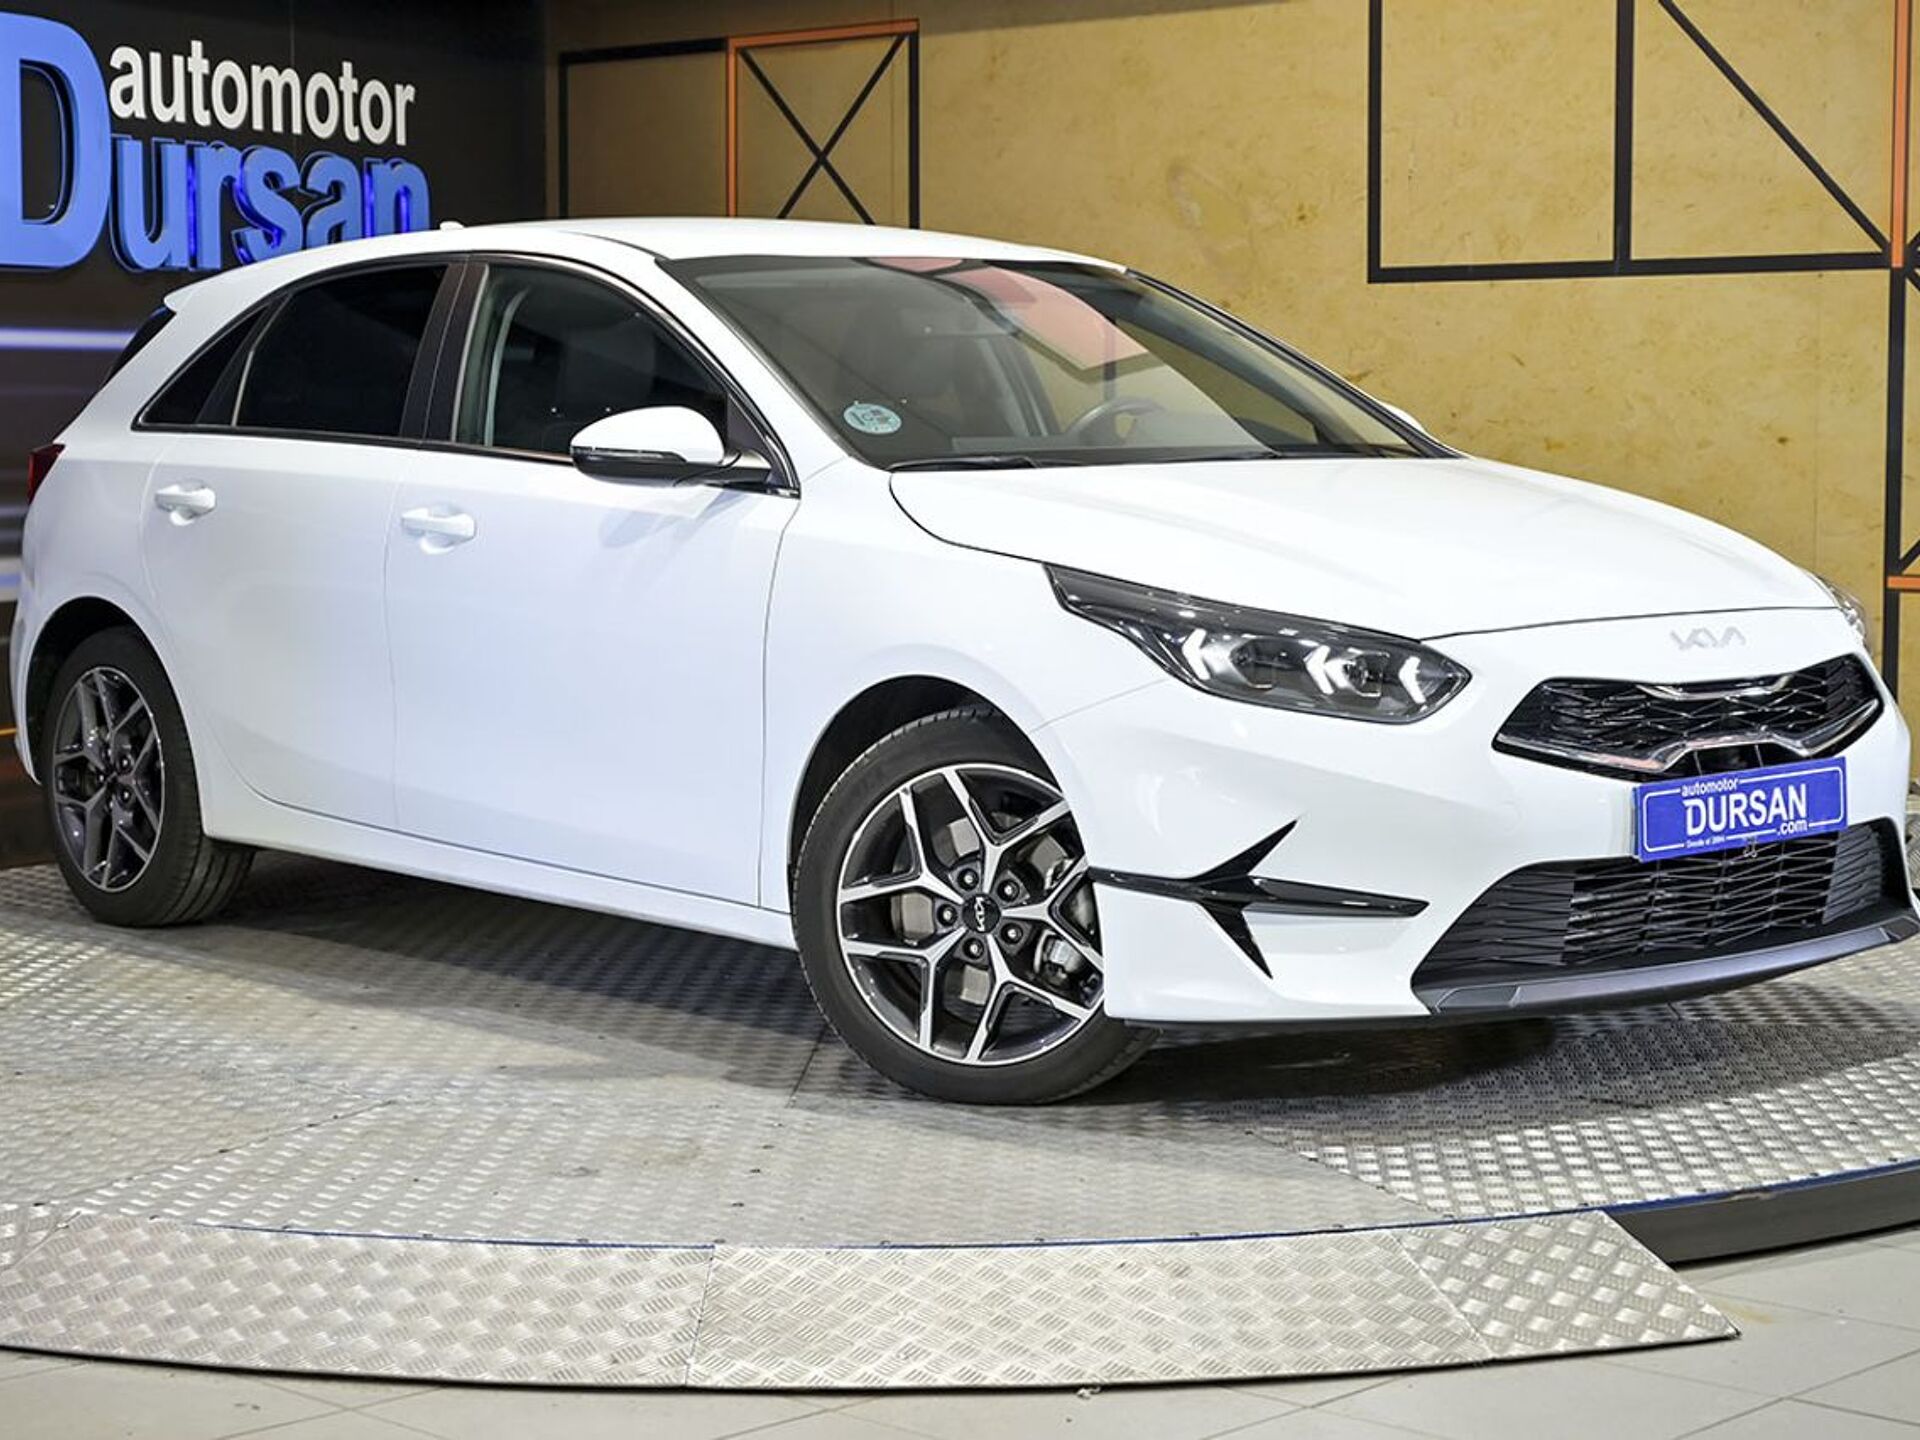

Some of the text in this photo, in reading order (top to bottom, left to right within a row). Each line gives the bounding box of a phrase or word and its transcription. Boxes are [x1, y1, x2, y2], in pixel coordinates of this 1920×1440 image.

[109, 40, 416, 145] automotor
[0, 12, 430, 271] Dursan
[1681, 778, 1738, 797] automotor
[1682, 783, 1807, 836] DURSAN
[1777, 820, 1808, 835] .com
